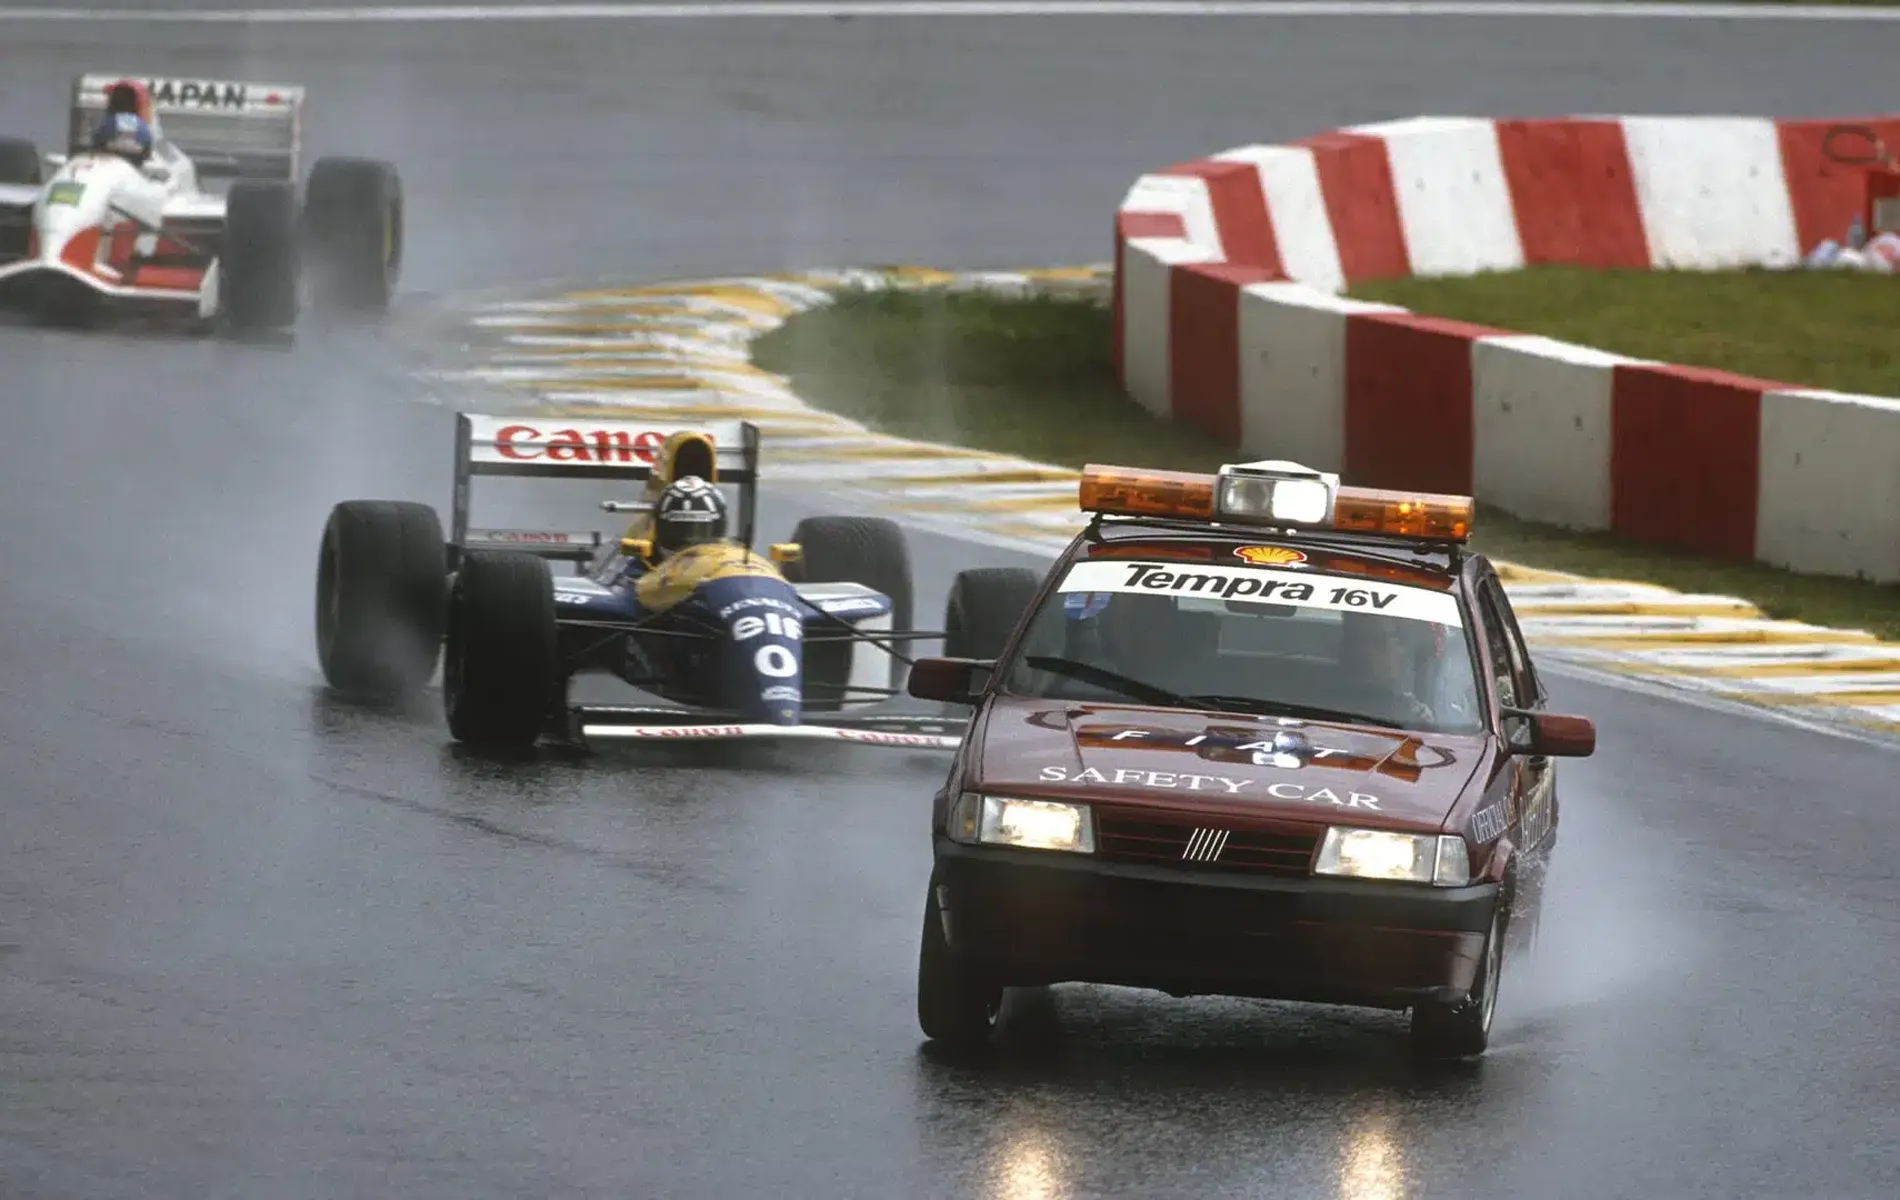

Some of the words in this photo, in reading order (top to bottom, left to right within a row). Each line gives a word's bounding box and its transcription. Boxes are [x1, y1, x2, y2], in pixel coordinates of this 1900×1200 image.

[494, 425, 716, 463] Cano
[1125, 564, 1316, 601] Tempra
[1329, 587, 1398, 610] 16V
[732, 613, 803, 641] elf
[754, 644, 798, 678] 0
[1039, 766, 1253, 794] SAFETY
[1267, 783, 1382, 810] CAR
